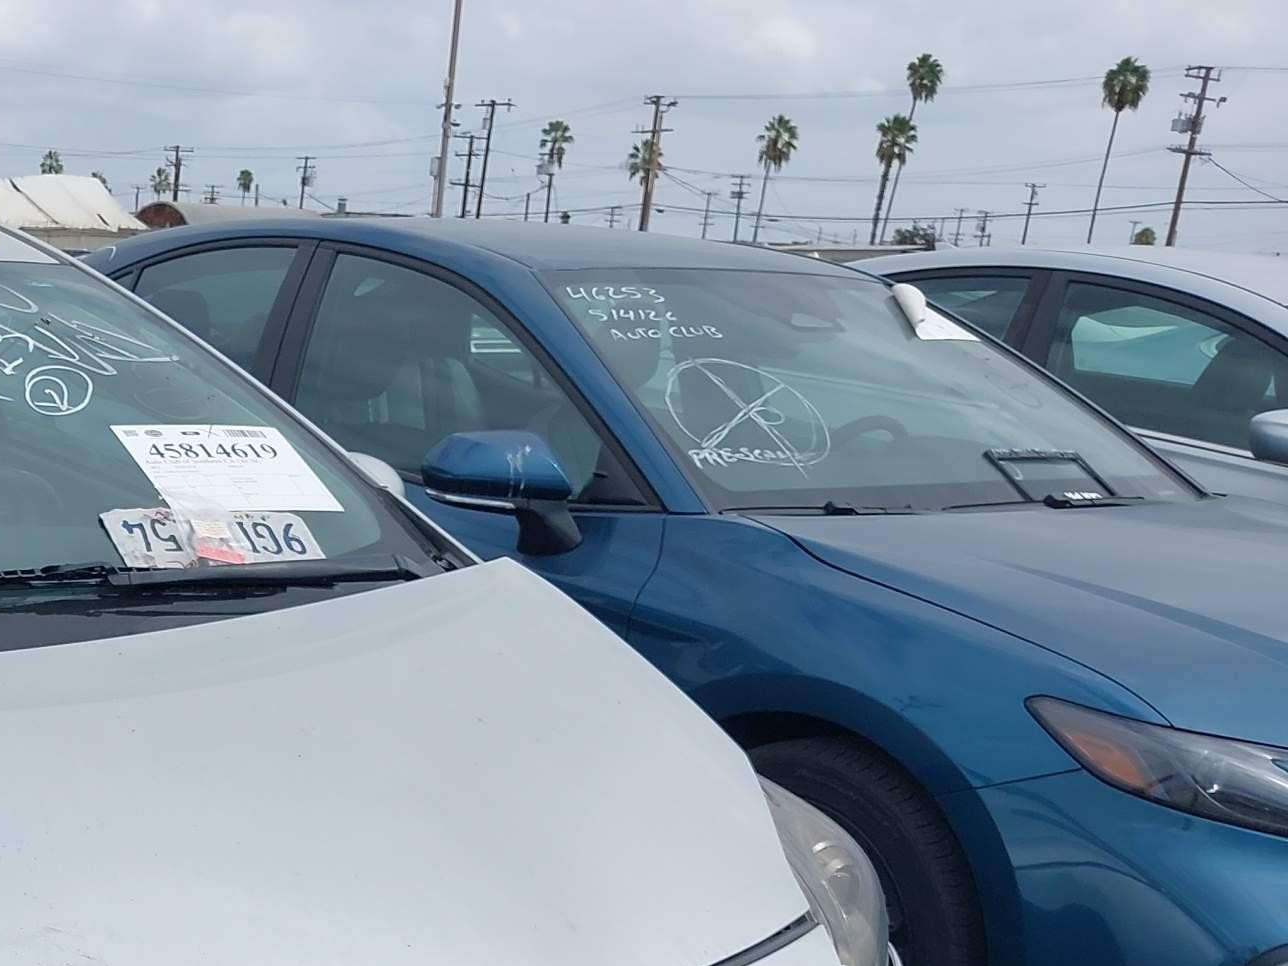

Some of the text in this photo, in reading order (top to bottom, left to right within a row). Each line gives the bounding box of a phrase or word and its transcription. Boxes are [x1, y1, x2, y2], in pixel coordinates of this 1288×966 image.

[565, 286, 665, 304] 46253
[668, 324, 724, 339] CLUB
[148, 443, 278, 459] 45814619
